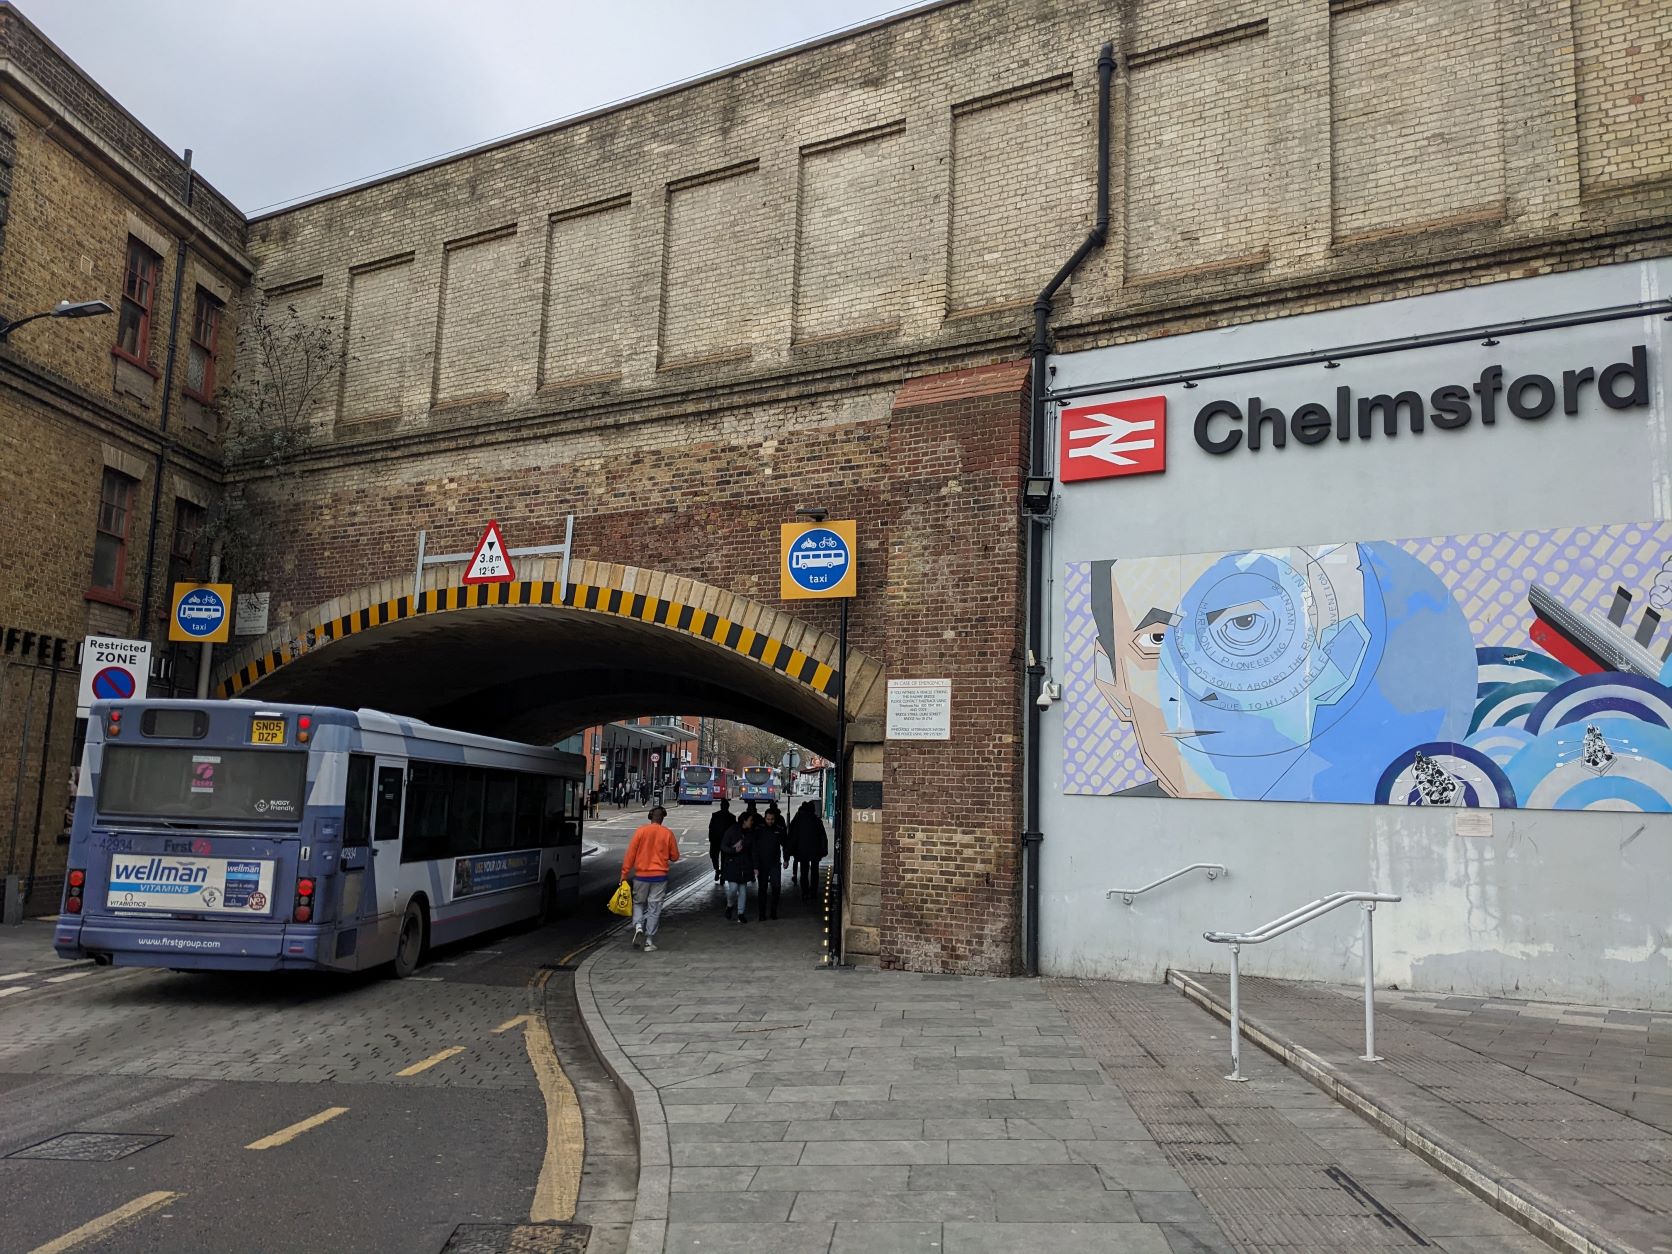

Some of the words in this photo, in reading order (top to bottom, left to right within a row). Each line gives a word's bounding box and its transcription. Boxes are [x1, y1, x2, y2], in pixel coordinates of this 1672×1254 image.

[1193, 345, 1650, 455] Chelmsford
[808, 573, 828, 584] taxi
[192, 623, 208, 631] taxi
[1220, 642, 1287, 671] PIONEERING
[1271, 583, 1295, 633] INVENTOR
[0, 627, 68, 664] FFEE
[90, 639, 147, 653] Restricted
[95, 651, 138, 665] ZONE
[1209, 675, 1243, 691] SOULS
[1246, 670, 1288, 691] ABOARD
[1288, 654, 1305, 674] THE
[1219, 701, 1241, 711] DUE
[1248, 702, 1263, 711] TO
[1265, 696, 1288, 707] HIS
[255, 722, 282, 731] SN05
[257, 732, 278, 742] DZP
[856, 811, 876, 822] 151
[101, 839, 133, 851] 42934
[164, 840, 192, 853] First
[140, 885, 190, 894] VITAMINS
[110, 900, 147, 908] VITABIOTICS
[138, 938, 221, 949] www.firstgroup.com
